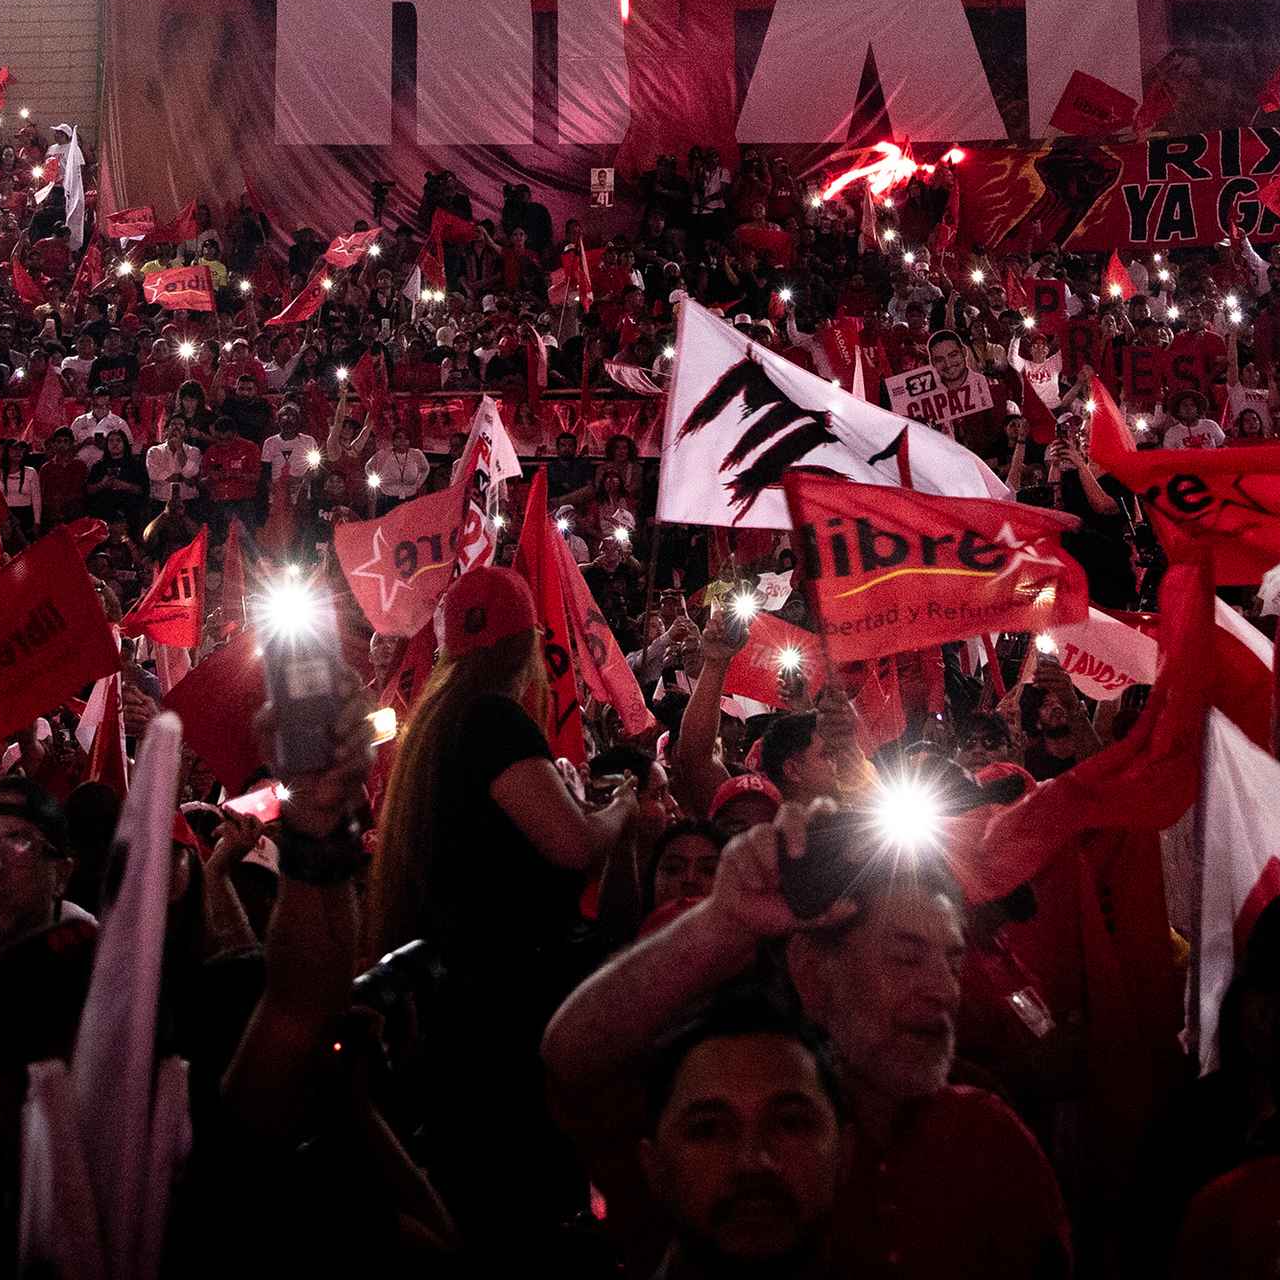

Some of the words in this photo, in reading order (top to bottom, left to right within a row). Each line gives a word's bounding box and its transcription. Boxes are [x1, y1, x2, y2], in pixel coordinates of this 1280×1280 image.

[1121, 182, 1199, 243] YA
[907, 384, 976, 421] CAPAZ
[908, 372, 932, 396] 37
[801, 517, 1010, 578] libre
